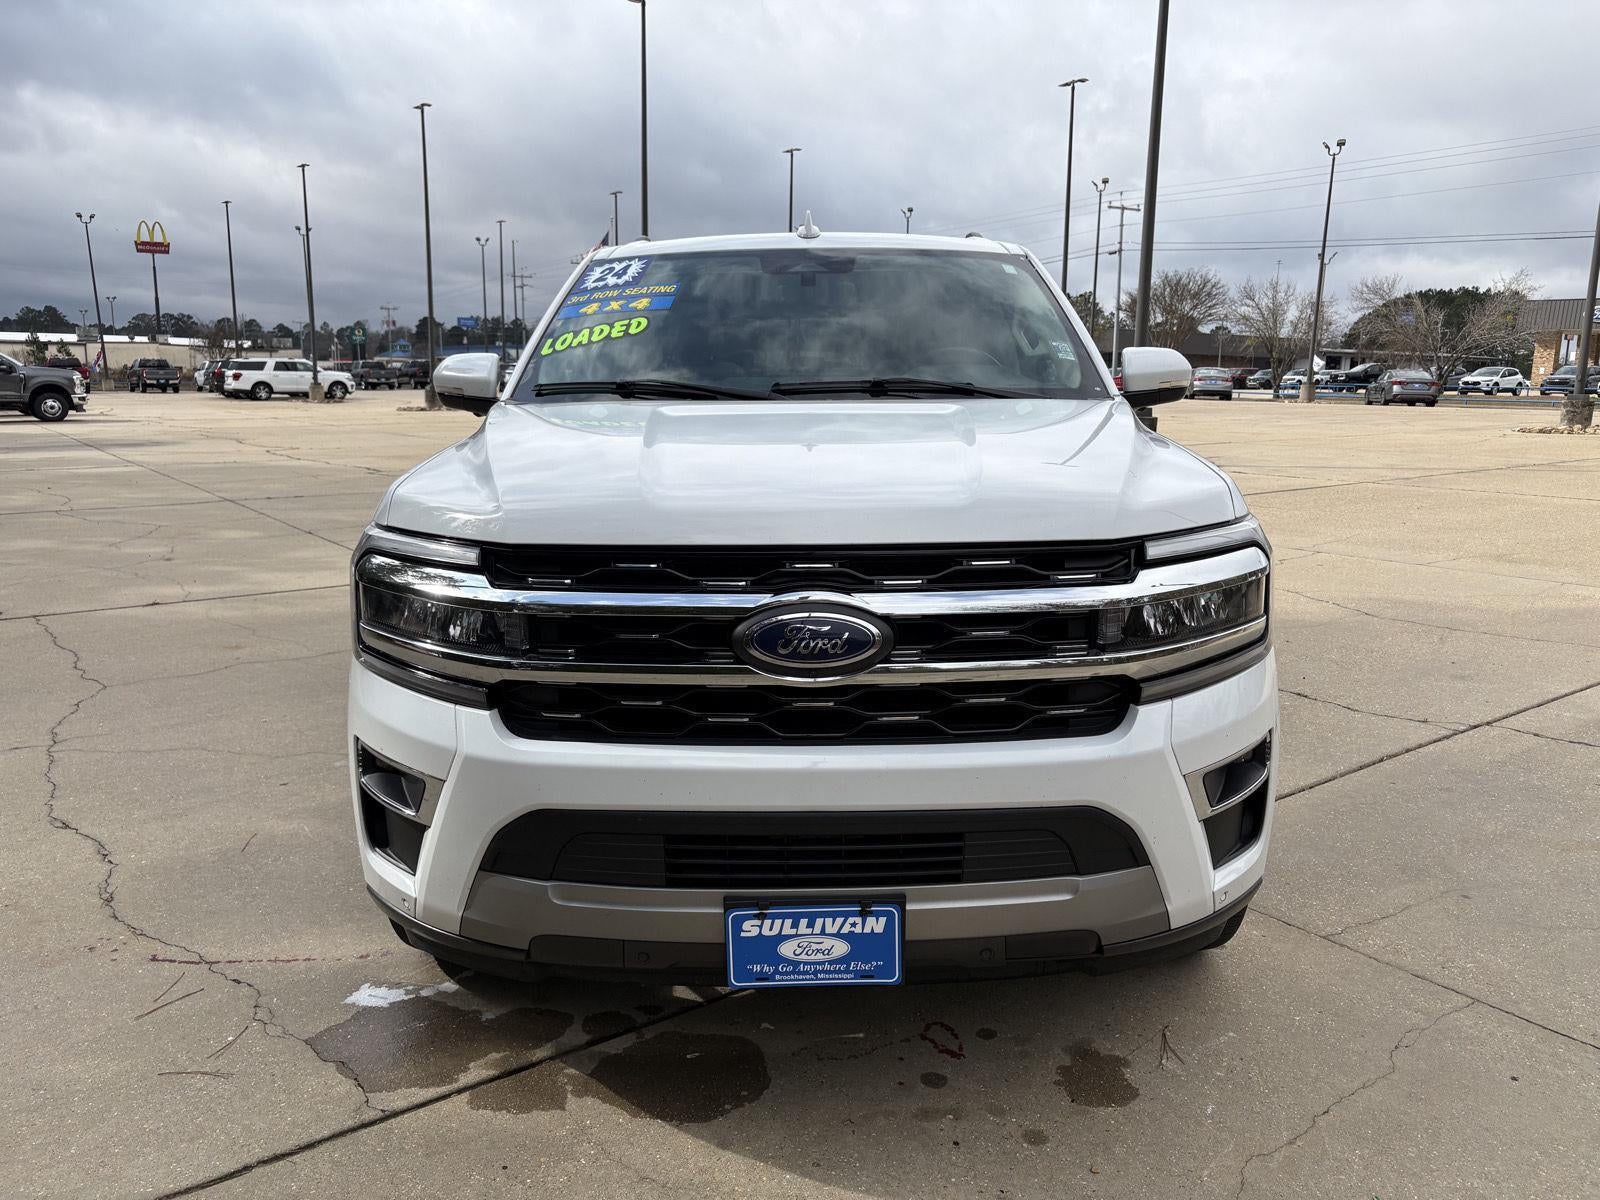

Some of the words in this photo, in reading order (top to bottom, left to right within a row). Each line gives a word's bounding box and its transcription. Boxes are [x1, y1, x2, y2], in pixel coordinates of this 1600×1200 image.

[592, 263, 633, 284] 24
[567, 294, 590, 304] 3rd
[591, 289, 622, 299] ROW
[623, 285, 677, 296] SEATING
[540, 316, 649, 357] LOADED
[776, 624, 849, 655] Ford
[740, 916, 887, 937] SULLIVAN
[792, 940, 835, 957] Ford
[778, 963, 793, 972] Go
[796, 962, 847, 974] Anywhere
